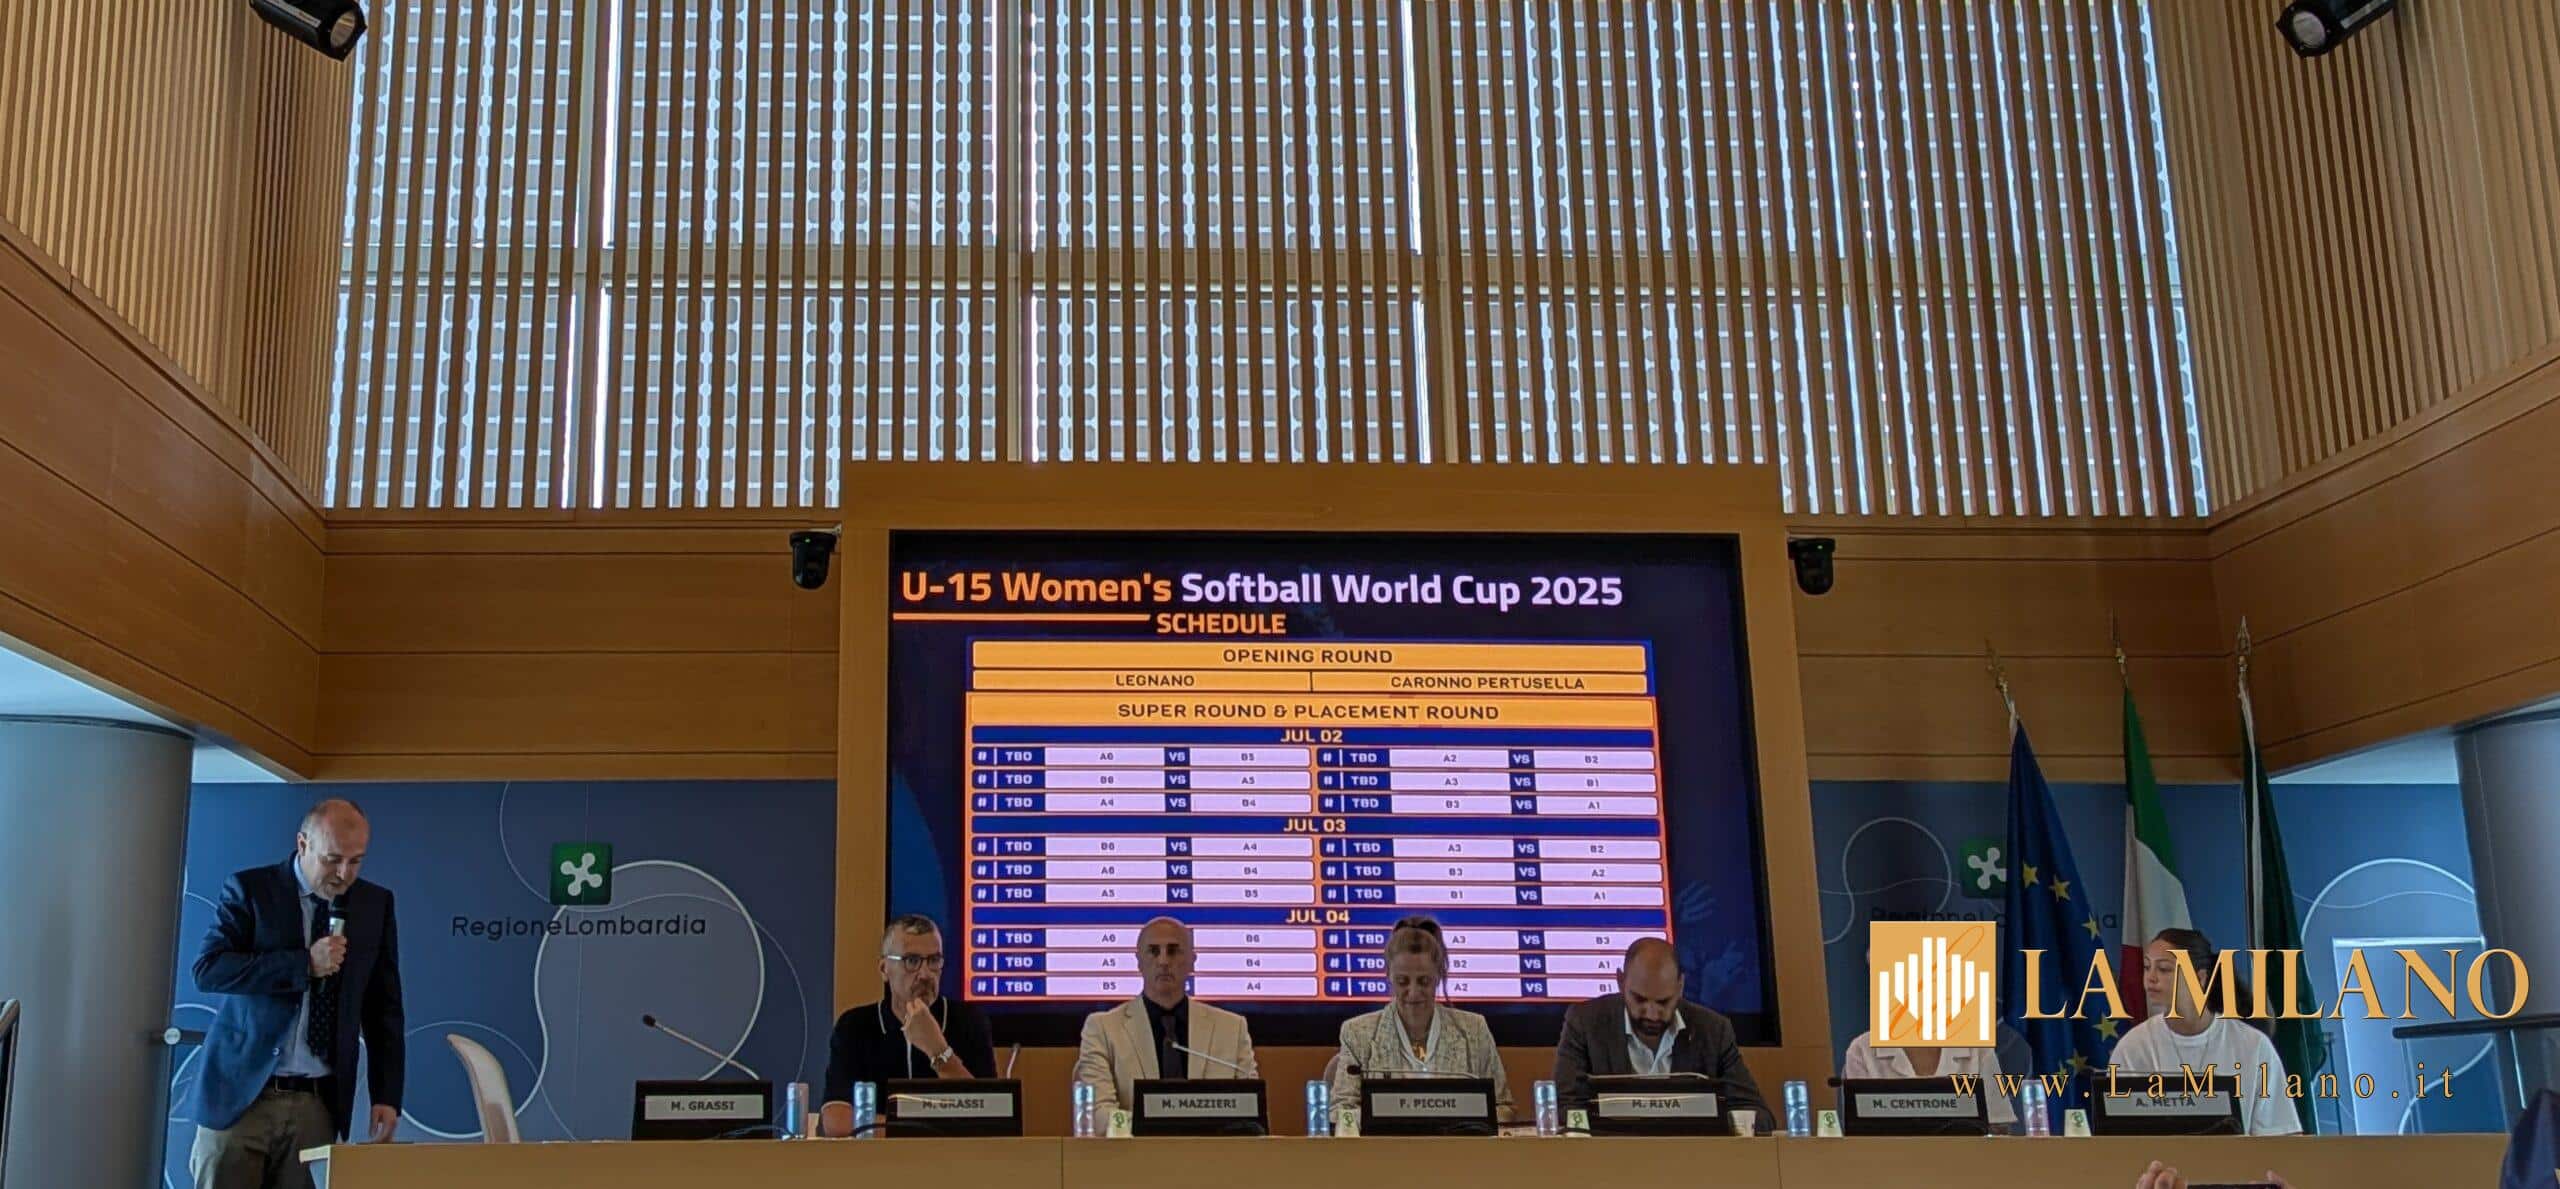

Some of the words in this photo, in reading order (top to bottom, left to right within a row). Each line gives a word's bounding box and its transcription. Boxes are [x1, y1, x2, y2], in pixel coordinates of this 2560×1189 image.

[903, 572, 991, 601] U-15
[1002, 573, 1171, 601] Women's
[1182, 573, 1321, 602] Softball
[1332, 574, 1441, 603] World
[1453, 576, 1520, 612] Cup
[1531, 577, 1622, 605] 2025
[1157, 613, 1286, 633] SCHEDULE
[1224, 649, 1314, 662] OPENING
[1322, 650, 1392, 663] ROUND
[1116, 675, 1194, 686] LEGNANO
[1391, 677, 1472, 688] CARONNO
[1478, 677, 1584, 689] PERTUSELLA
[1119, 704, 1186, 717] SUPER
[1195, 705, 1266, 717] ROUND
[1274, 705, 1287, 717] &
[1295, 705, 1419, 719] PLACEMENT
[1427, 706, 1498, 719] ROUND
[1281, 730, 1315, 742] JUL
[1321, 730, 1342, 742] 02
[1006, 752, 1032, 761] TBD
[1169, 752, 1185, 761] VS
[1350, 753, 1377, 762] TBD
[1513, 754, 1530, 763] VS
[1006, 774, 1032, 784] TBD
[1170, 775, 1186, 784] VS
[1351, 776, 1378, 785] TBD
[1514, 777, 1531, 786] VS
[1006, 798, 1032, 807] TBD
[1170, 798, 1186, 807] VS
[1352, 798, 1379, 808] TBD
[1516, 800, 1532, 809] VS
[1284, 819, 1318, 832] JUL
[1324, 819, 1345, 832] 03
[1005, 841, 1032, 851] TBD
[1171, 842, 1187, 851] VS
[1354, 843, 1380, 852] TBD
[1518, 844, 1535, 853] VS
[1006, 865, 1032, 874] TBD
[1171, 865, 1187, 874] VS
[1355, 866, 1381, 876] TBD
[1519, 867, 1536, 876] VS
[1006, 888, 1032, 898] TBD
[1172, 888, 1188, 898] VS
[1355, 889, 1382, 898] TBD
[1520, 891, 1537, 900] VS
[1286, 910, 1321, 923] JUL
[1326, 910, 1349, 923] 04
[452, 914, 706, 940] RegioneLombardia
[1005, 933, 1032, 943] TBD
[1357, 934, 1384, 944] TBD
[1523, 935, 1540, 944] VS
[1005, 957, 1033, 967] TBD
[1358, 958, 1385, 968] TBD
[1524, 959, 1541, 968] VS
[1006, 982, 1033, 992] TBD
[1359, 982, 1386, 992] TBD
[1526, 983, 1542, 992] VS
[671, 1101, 685, 1111] M.
[688, 1100, 736, 1111] GRASSI
[1162, 1099, 1174, 1108] M.
[1179, 1099, 1236, 1108] MAZZIERI
[1400, 1099, 1409, 1108] F.
[1414, 1099, 1456, 1108] PICCHI
[1632, 1099, 1647, 1108] M.
[1649, 1099, 1681, 1108] RIVA
[1873, 1099, 1887, 1109] M.
[1890, 1099, 1957, 1109] CENTRONE
[2136, 1097, 2148, 1107] A.
[2153, 1097, 2195, 1107] METTA
